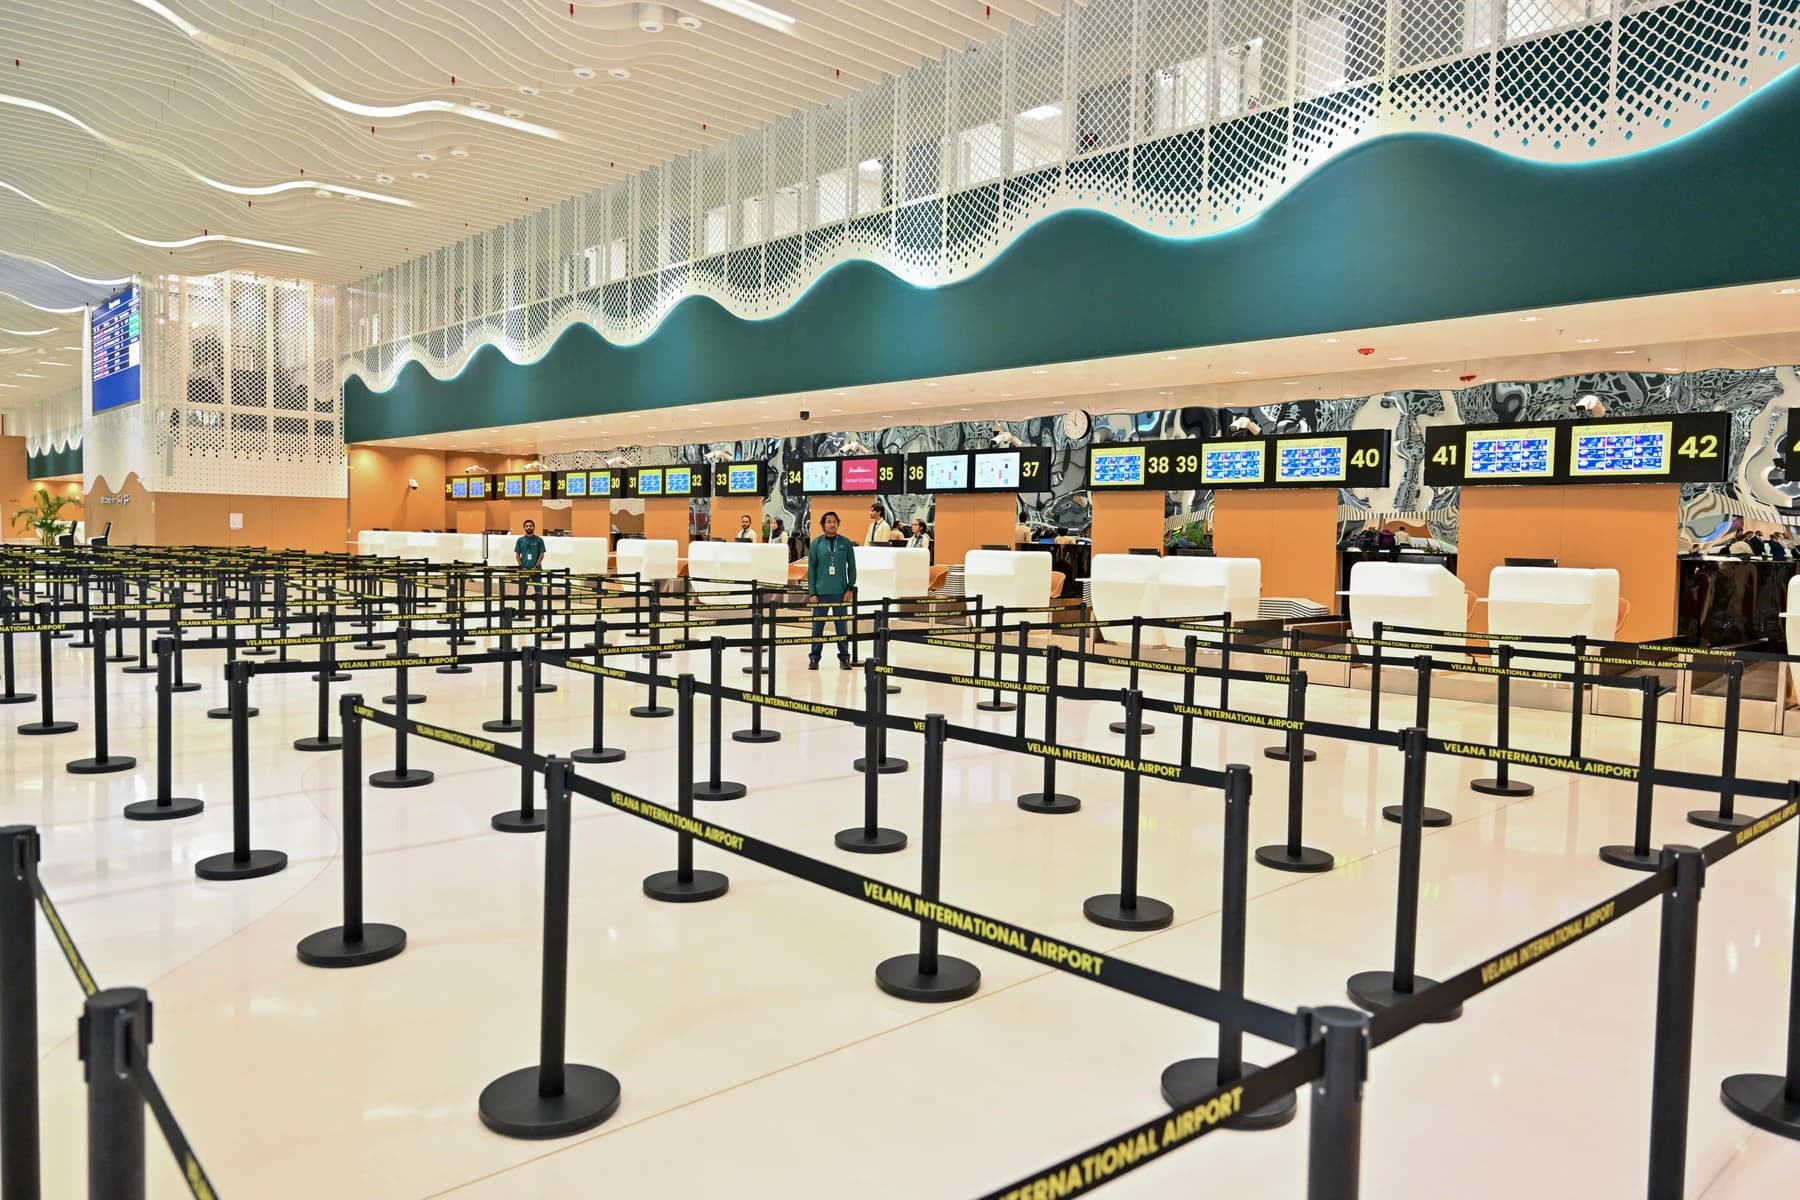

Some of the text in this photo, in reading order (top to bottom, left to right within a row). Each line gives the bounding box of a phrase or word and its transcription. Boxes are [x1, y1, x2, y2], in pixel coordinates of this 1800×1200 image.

[1678, 435, 1718, 459] 42
[1350, 449, 1381, 469] 40
[1432, 445, 1457, 466] 41
[1022, 462, 1040, 477] 37
[1148, 456, 1170, 474] 38
[1175, 455, 1198, 473] 39
[716, 473, 727, 486] 33
[788, 471, 801, 484] 34
[880, 467, 894, 481] 35
[908, 466, 924, 480] 36
[497, 482, 505, 492] 27
[543, 480, 551, 490] 28
[557, 480, 566, 490] 29
[611, 478, 621, 489] 30
[629, 477, 637, 488] 31
[692, 474, 702, 487] 32
[274, 637, 324, 646] INTERNATIONAL
[621, 646, 662, 654] INTERNATIONAL
[1264, 648, 1284, 656] VELANA
[1284, 650, 1327, 660] INTERNATIONAL
[1638, 644, 1661, 652] VELANA
[1662, 646, 1708, 656] INTERNATIONAL
[338, 656, 458, 670] VELANA INTERNATIONAL AIRPORT
[1108, 658, 1198, 674] VELANA INTERNATIONAL AIRPORT
[1578, 656, 1687, 669] VELANA INTERNATIONAL AIRPORT
[1265, 674, 1290, 682] VELANA
[1451, 664, 1562, 680] VELANA INTERNATIONAL AIRPORT
[952, 676, 1050, 694] VELANA INTERNATIONAL AIRPORT
[742, 692, 838, 717] VELANA INTERNATIONAL AIRPORT
[1173, 704, 1304, 731] VELANA INTERNATIONAL AIRPORT
[1027, 742, 1182, 779] VELANA INTERNATIONAL AIRPORT
[1444, 742, 1640, 778] VELANA INTERNATIONAL AIRPORT
[611, 792, 744, 851] VELANA INTERNATIONAL AIRPORT
[863, 880, 1104, 976] VELANA INTERNATIONAL AIRPORT
[1481, 901, 1616, 984] VELANA INTERNATIONAL AIRPORT
[1000, 1086, 1244, 1200] ERNATIONAL AIRPORT
